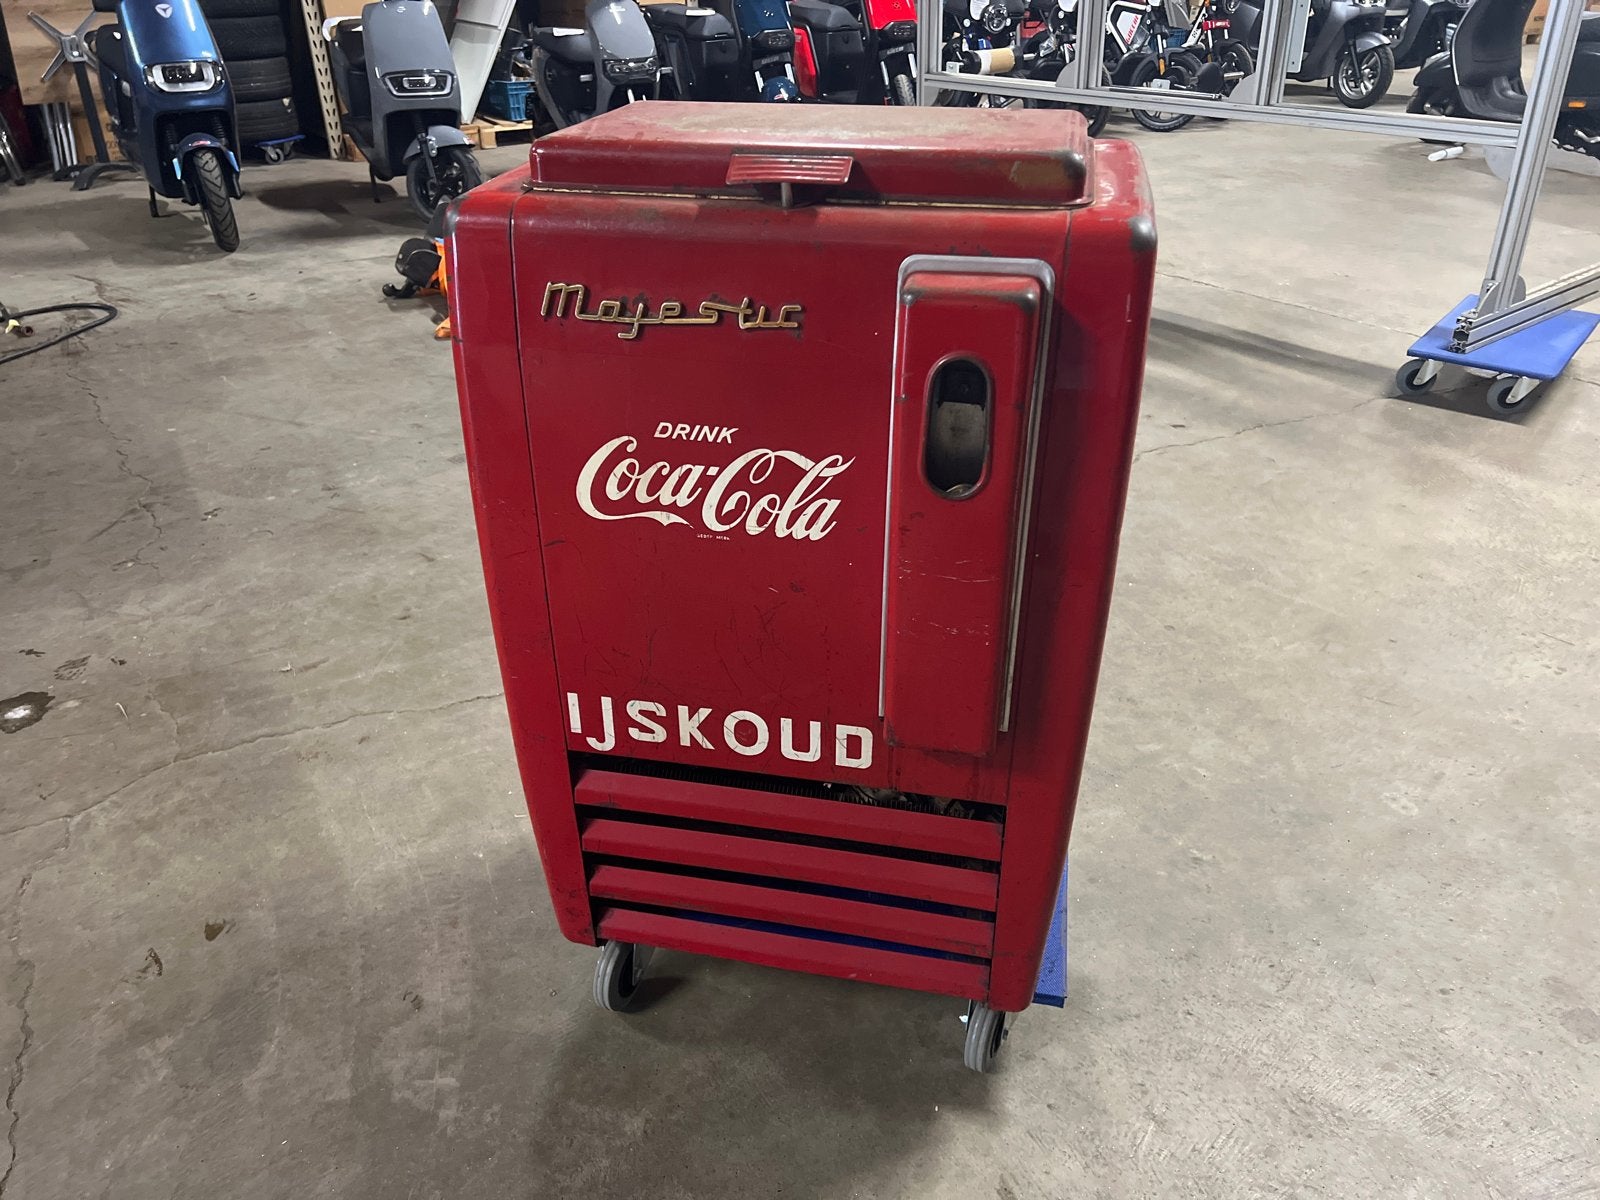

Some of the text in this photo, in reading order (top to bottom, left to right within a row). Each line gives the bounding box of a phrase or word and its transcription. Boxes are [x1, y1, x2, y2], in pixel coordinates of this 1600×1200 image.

[541, 281, 802, 340] Majestic
[653, 421, 739, 444] DRINK
[575, 435, 856, 541] Coca-Cola
[566, 691, 874, 770] IJSKOUD
